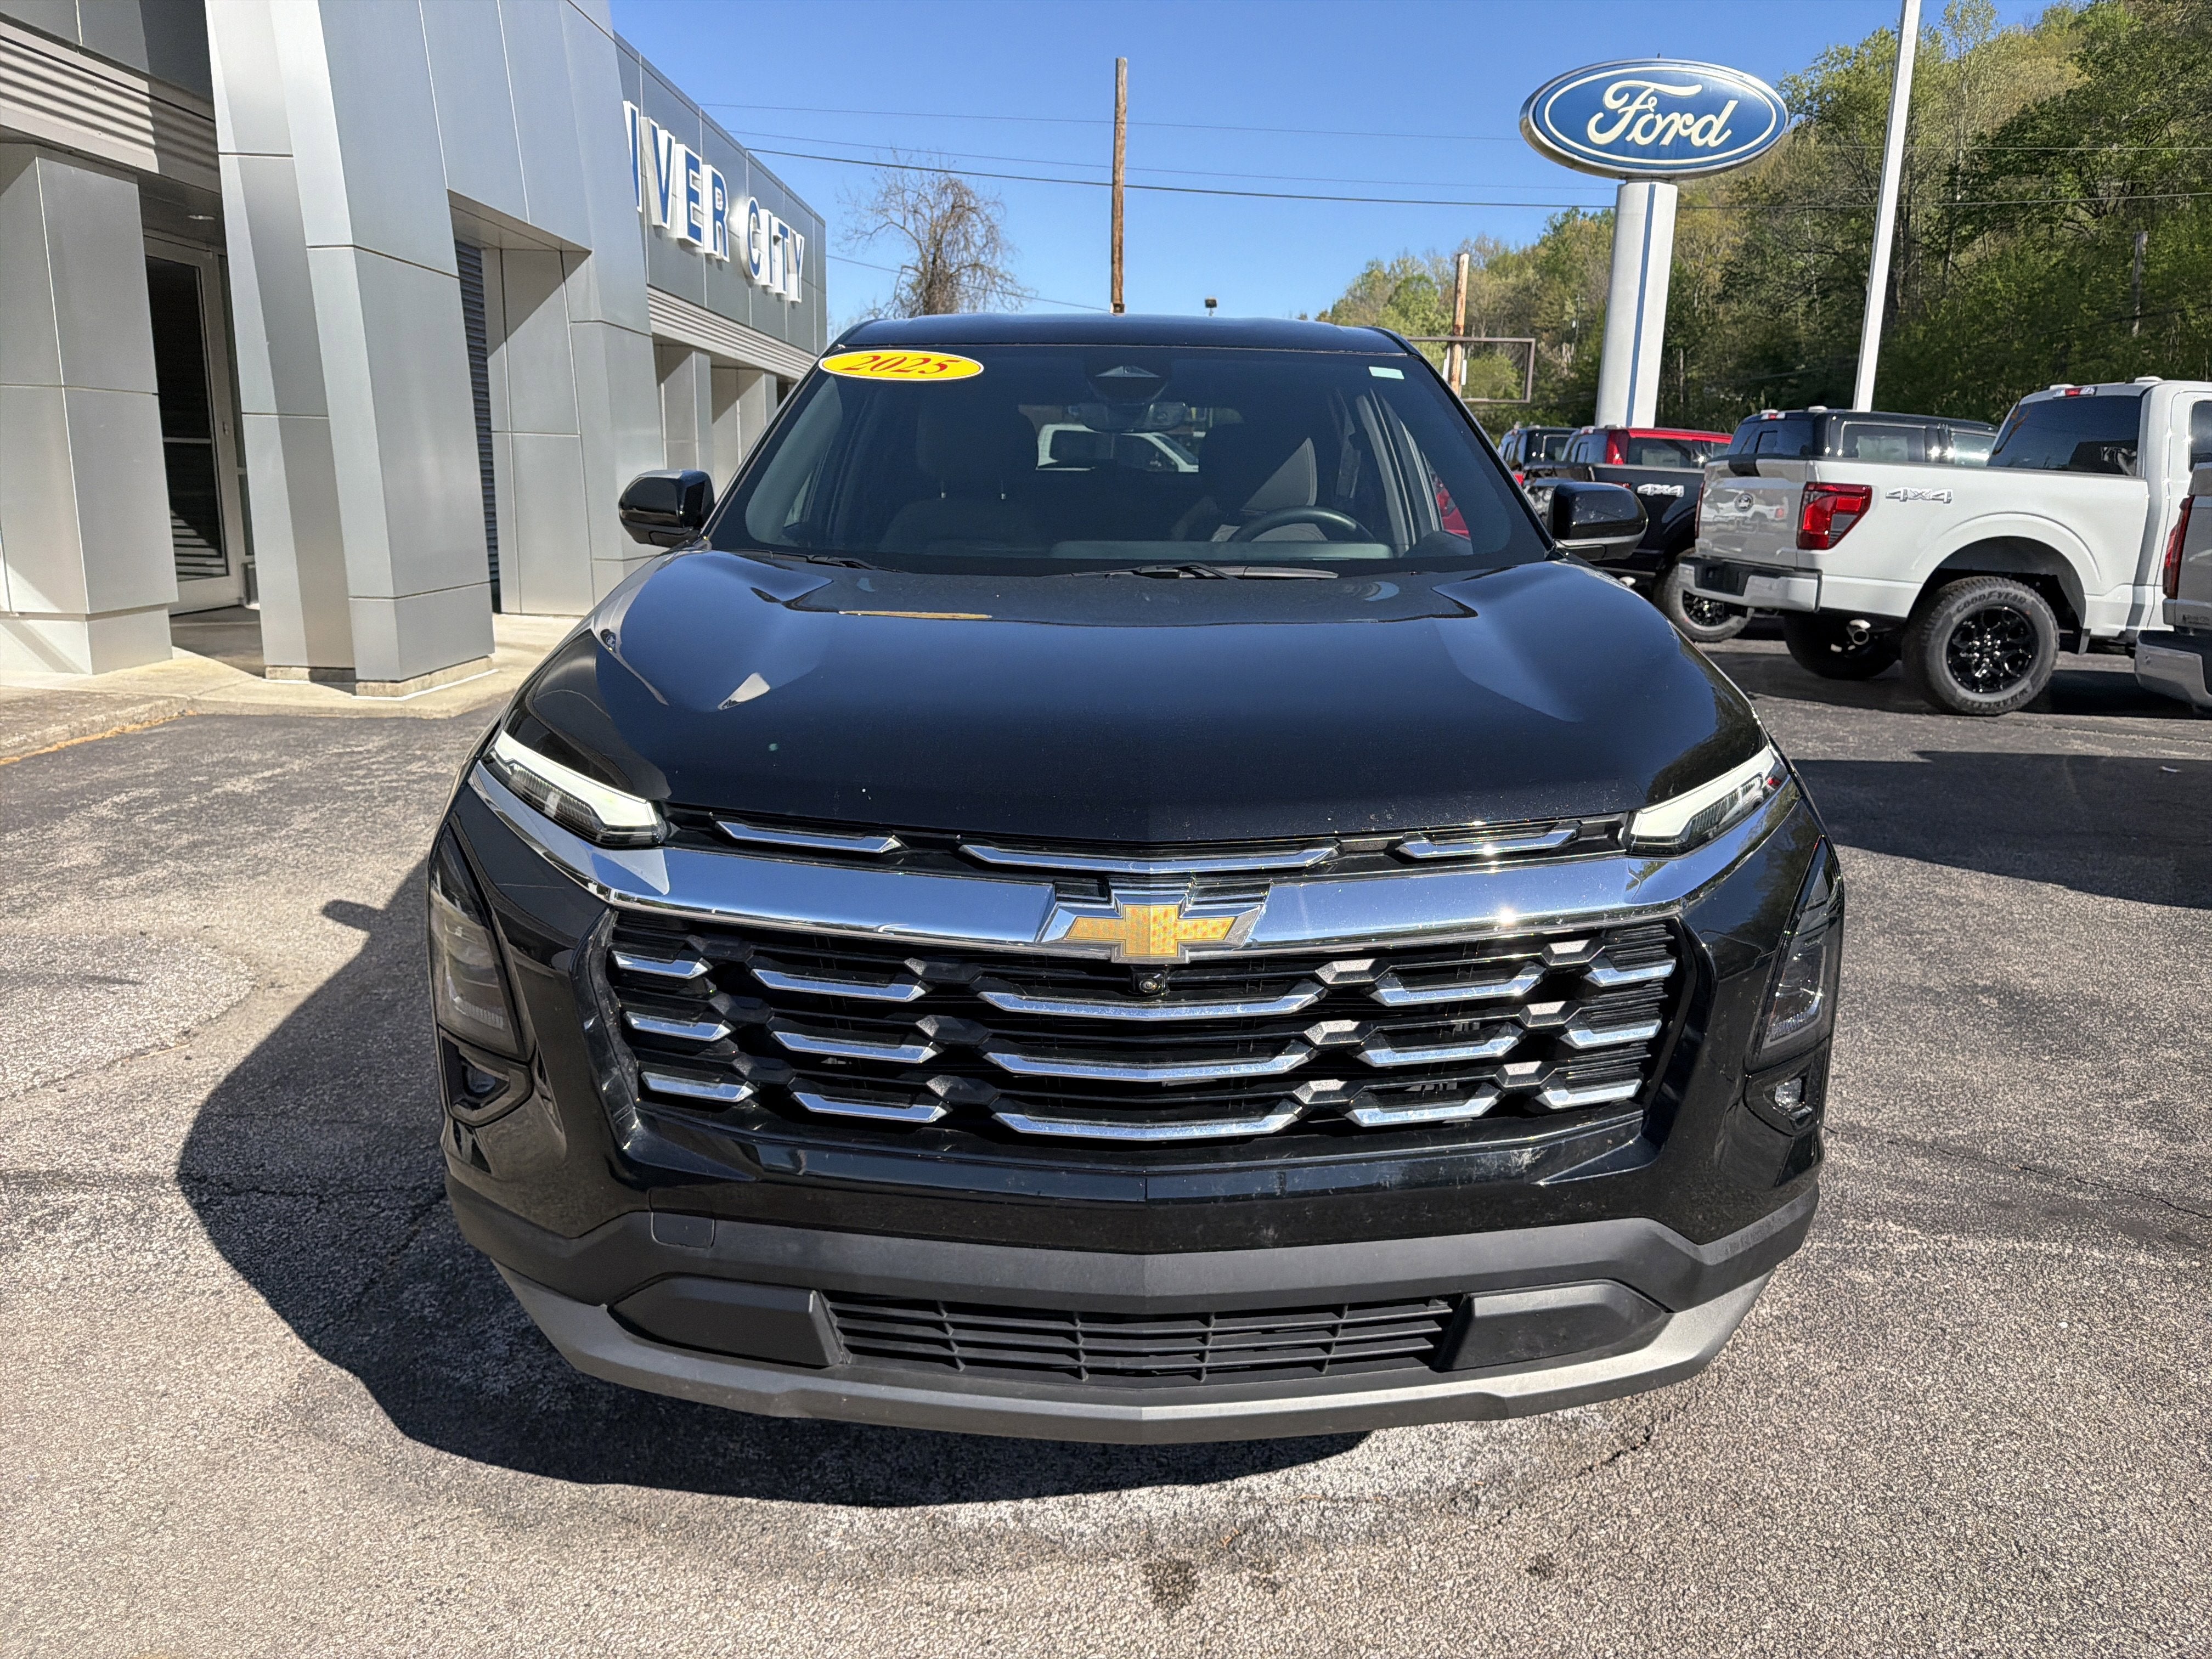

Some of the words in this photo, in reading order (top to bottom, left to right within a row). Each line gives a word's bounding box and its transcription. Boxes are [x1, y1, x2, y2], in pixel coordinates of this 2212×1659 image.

[1587, 80, 1739, 147] Ford
[741, 196, 804, 303] CITY
[841, 355, 962, 374] 2025
